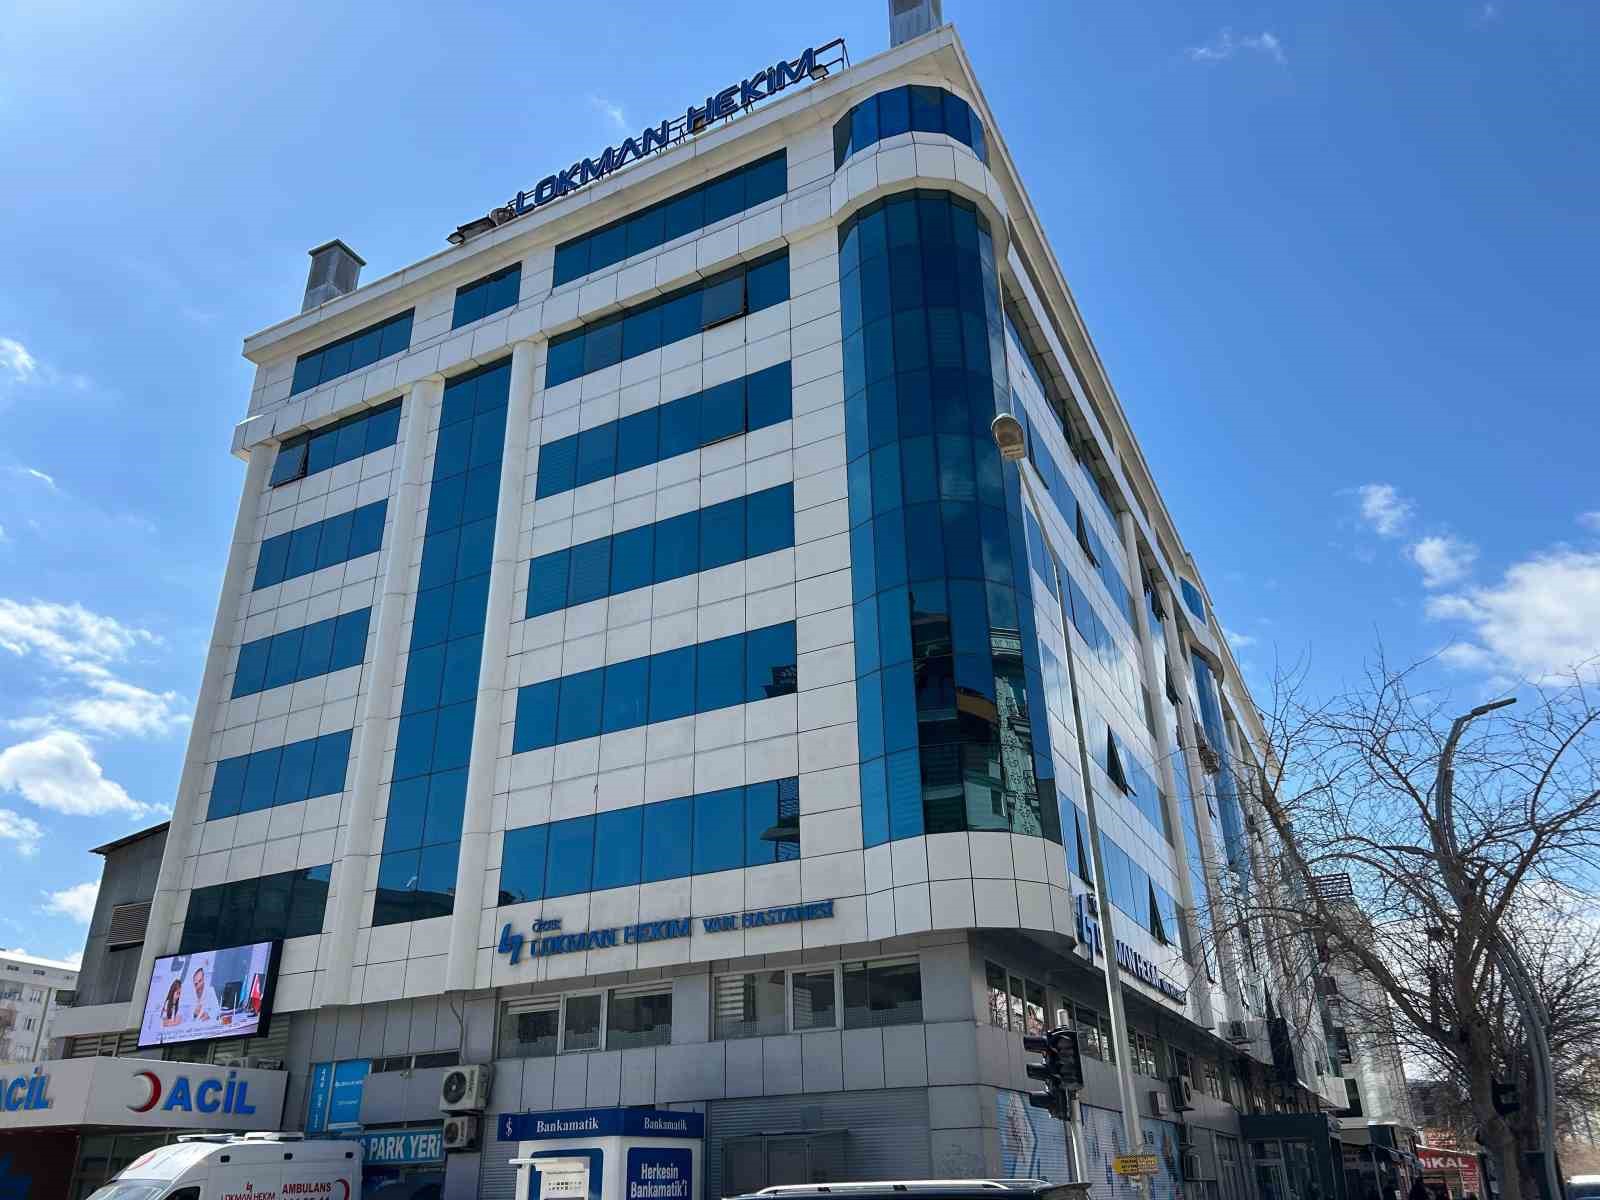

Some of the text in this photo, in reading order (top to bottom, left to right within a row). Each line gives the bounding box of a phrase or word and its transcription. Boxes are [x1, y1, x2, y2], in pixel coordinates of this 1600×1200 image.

[515, 119, 670, 215] LOKMAN
[530, 927, 618, 958] LOKMAN
[703, 905, 738, 933] VAN
[162, 1070, 256, 1115] ACİL
[536, 1115, 600, 1133] Bankamatik
[644, 1117, 688, 1131] Bankamatik
[369, 1136, 406, 1161] PARK
[410, 1134, 441, 1159] YERİ
[641, 1163, 679, 1180] Herkesin
[282, 1182, 332, 1195] AMBULANS
[630, 1180, 688, 1199] Bankamatik'i
